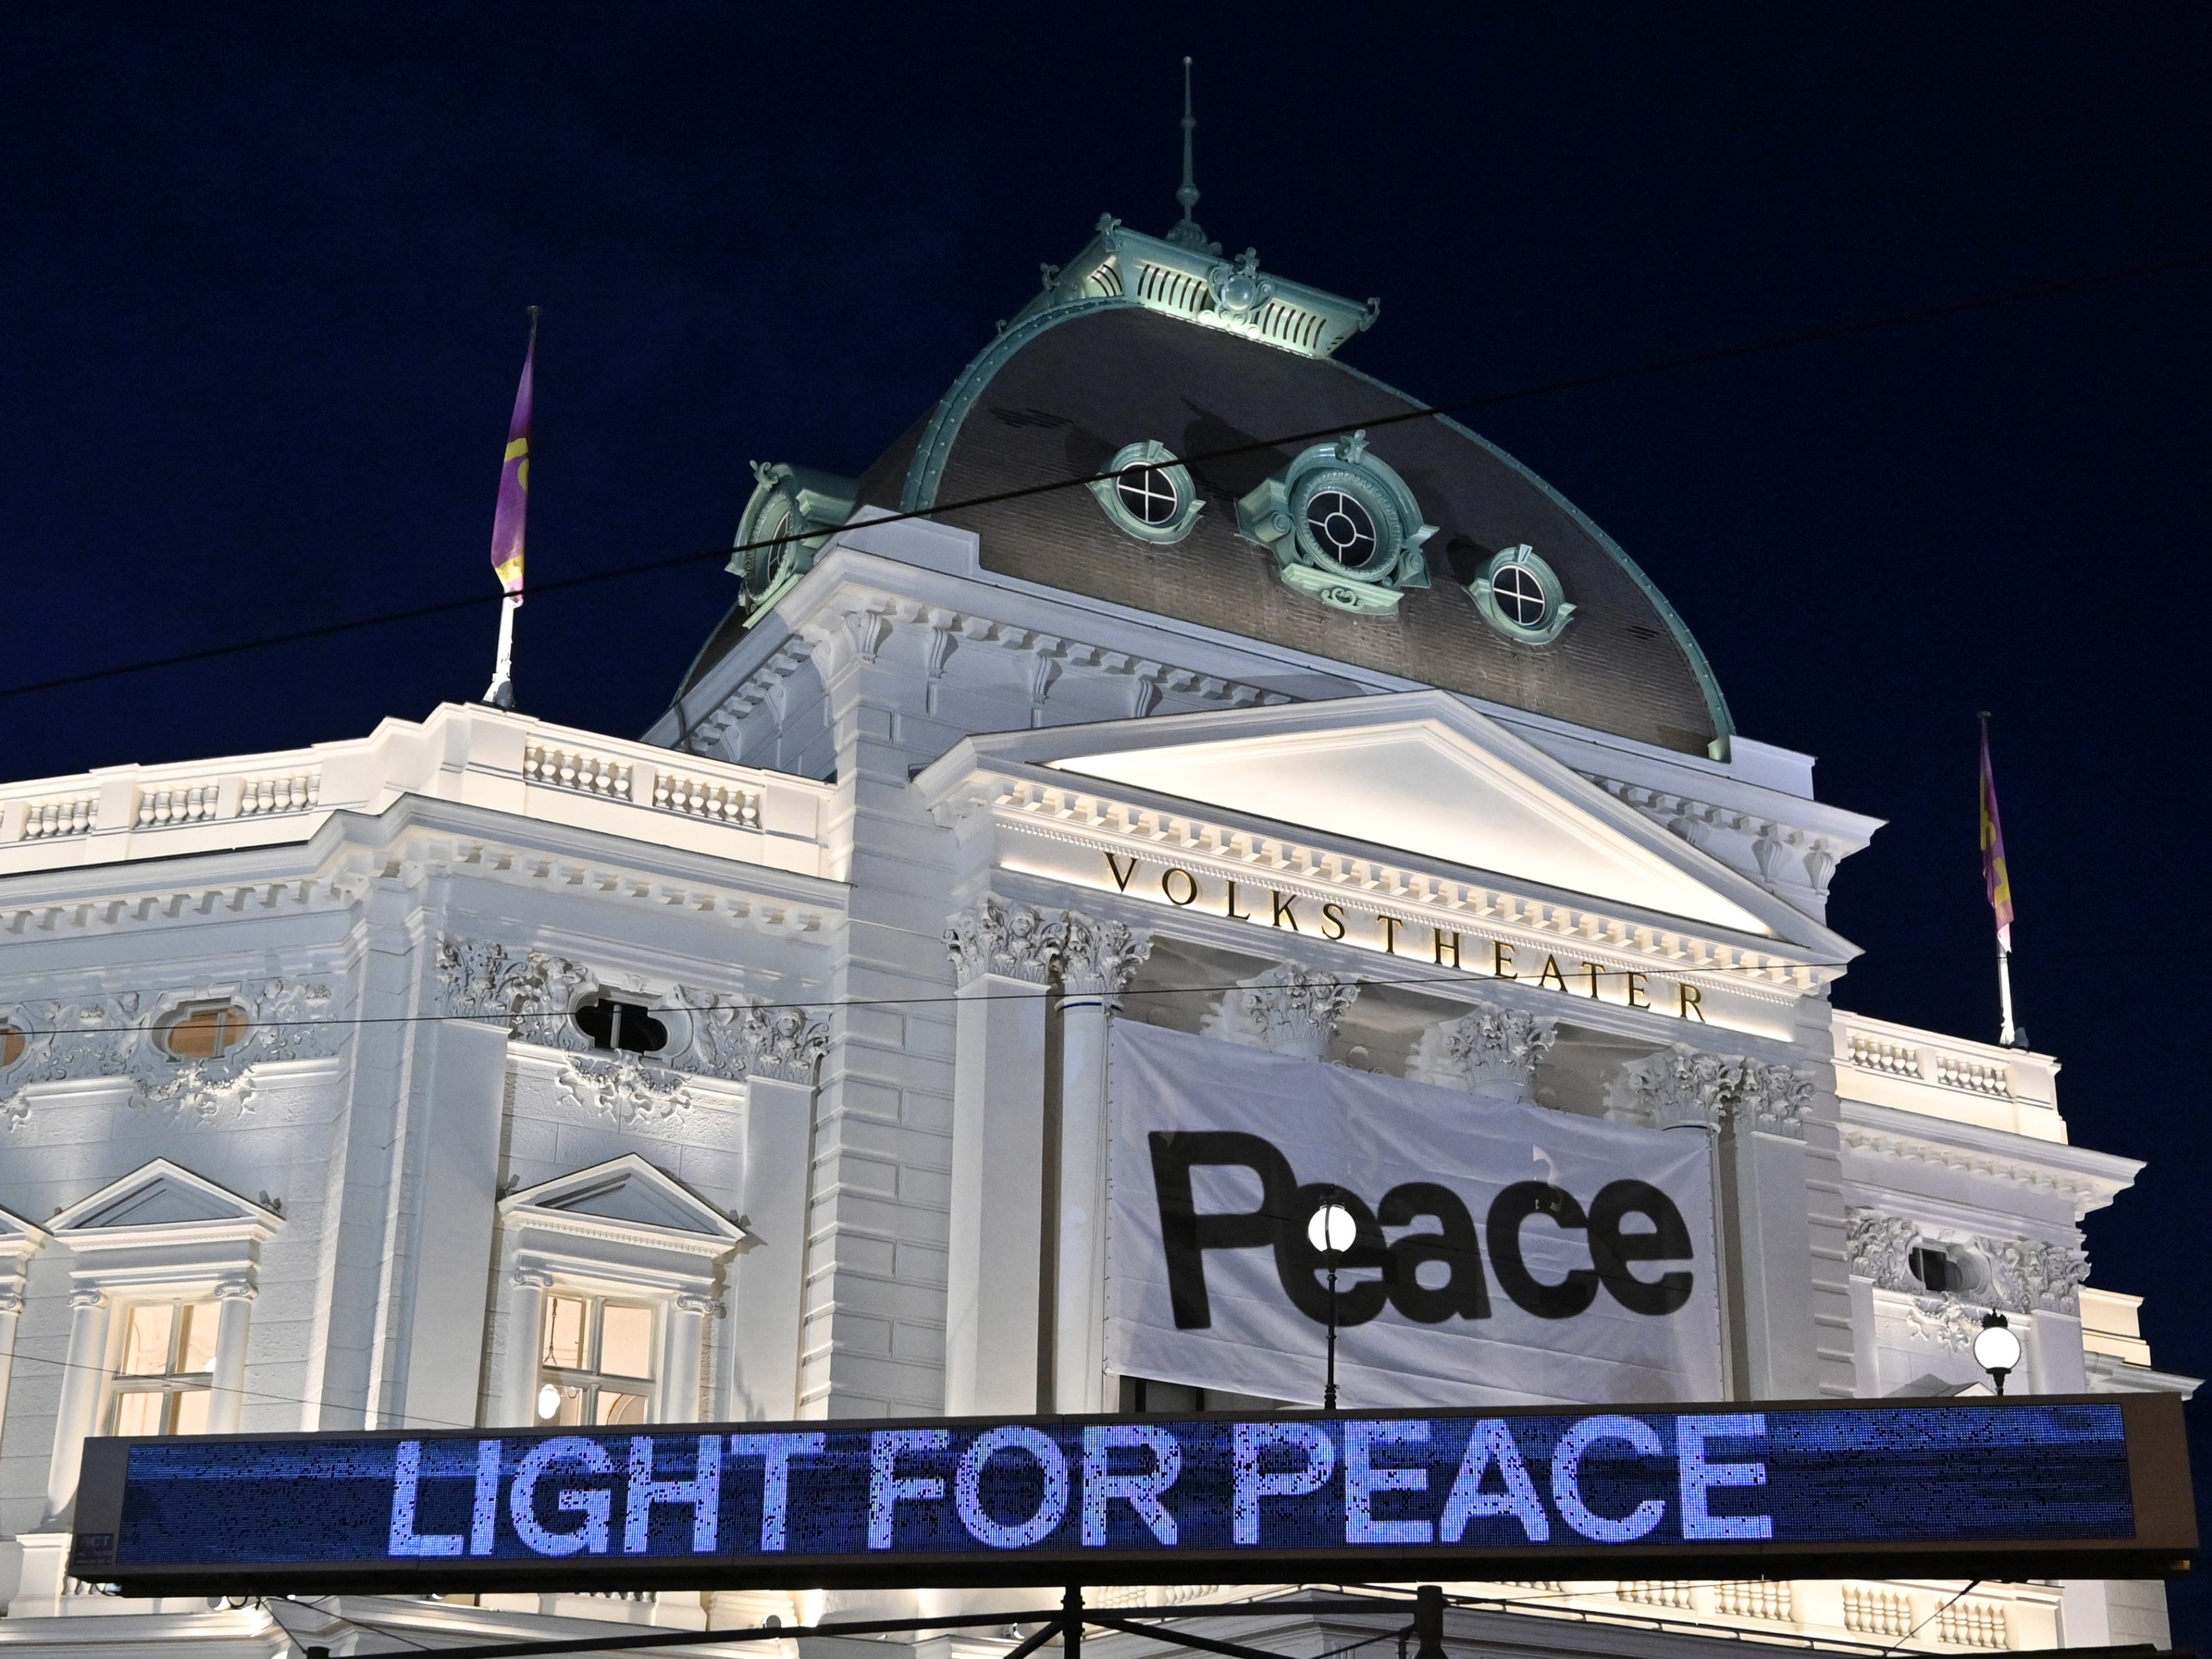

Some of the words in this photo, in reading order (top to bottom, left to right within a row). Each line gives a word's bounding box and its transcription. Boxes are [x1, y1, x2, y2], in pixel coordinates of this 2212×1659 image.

[1104, 852, 1706, 1022] VOLKSTHEATER
[1148, 1131, 1694, 1328] Peace
[388, 1434, 825, 1556] LIGHT
[867, 1424, 1180, 1549] FOR
[1232, 1414, 1773, 1545] PEACE
